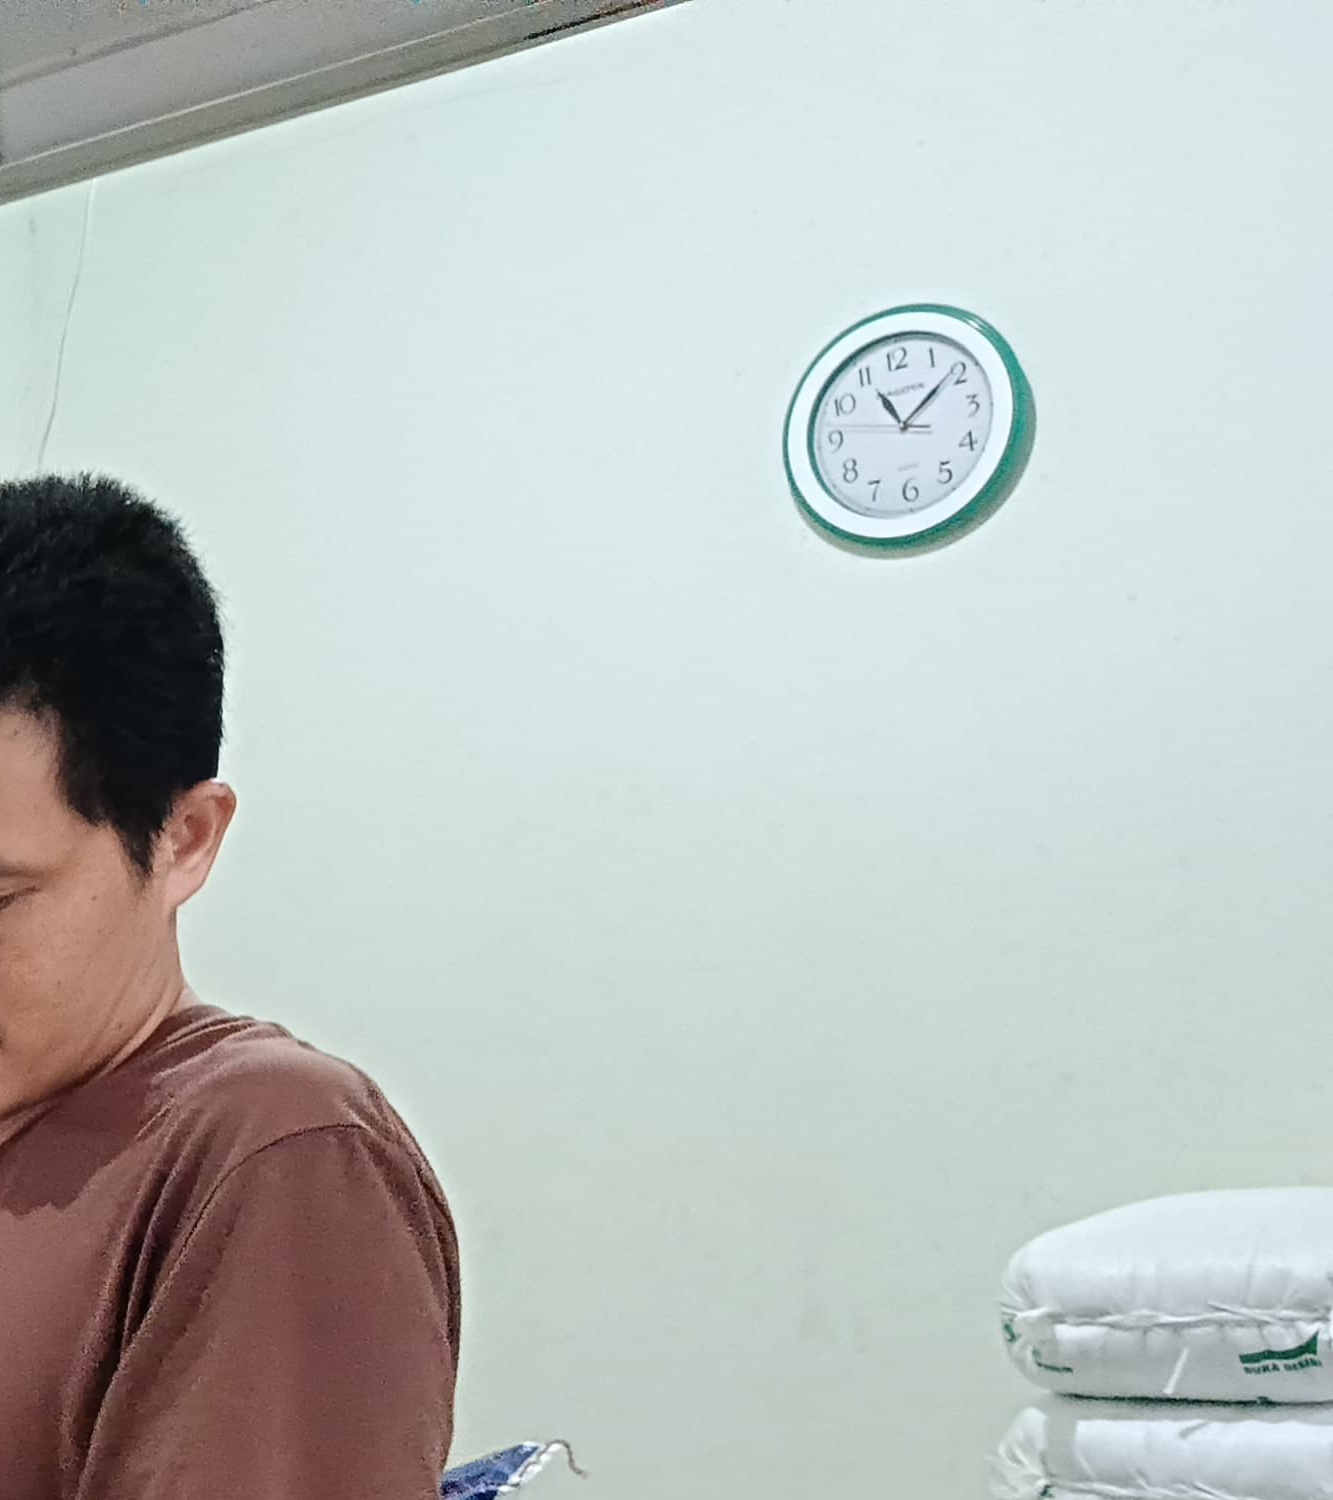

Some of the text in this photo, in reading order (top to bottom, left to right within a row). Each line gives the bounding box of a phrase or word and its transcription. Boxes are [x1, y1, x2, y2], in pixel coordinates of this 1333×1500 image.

[886, 346, 909, 373] 12
[928, 346, 936, 368] 1
[857, 366, 872, 387] 11
[950, 361, 967, 386] 2
[834, 393, 857, 417] 10
[965, 393, 981, 418] 3
[828, 430, 844, 454] 9
[957, 430, 978, 452] 4
[842, 458, 859, 483] 8
[936, 460, 953, 485] 5
[868, 479, 882, 502] 7
[901, 478, 920, 503] 6
